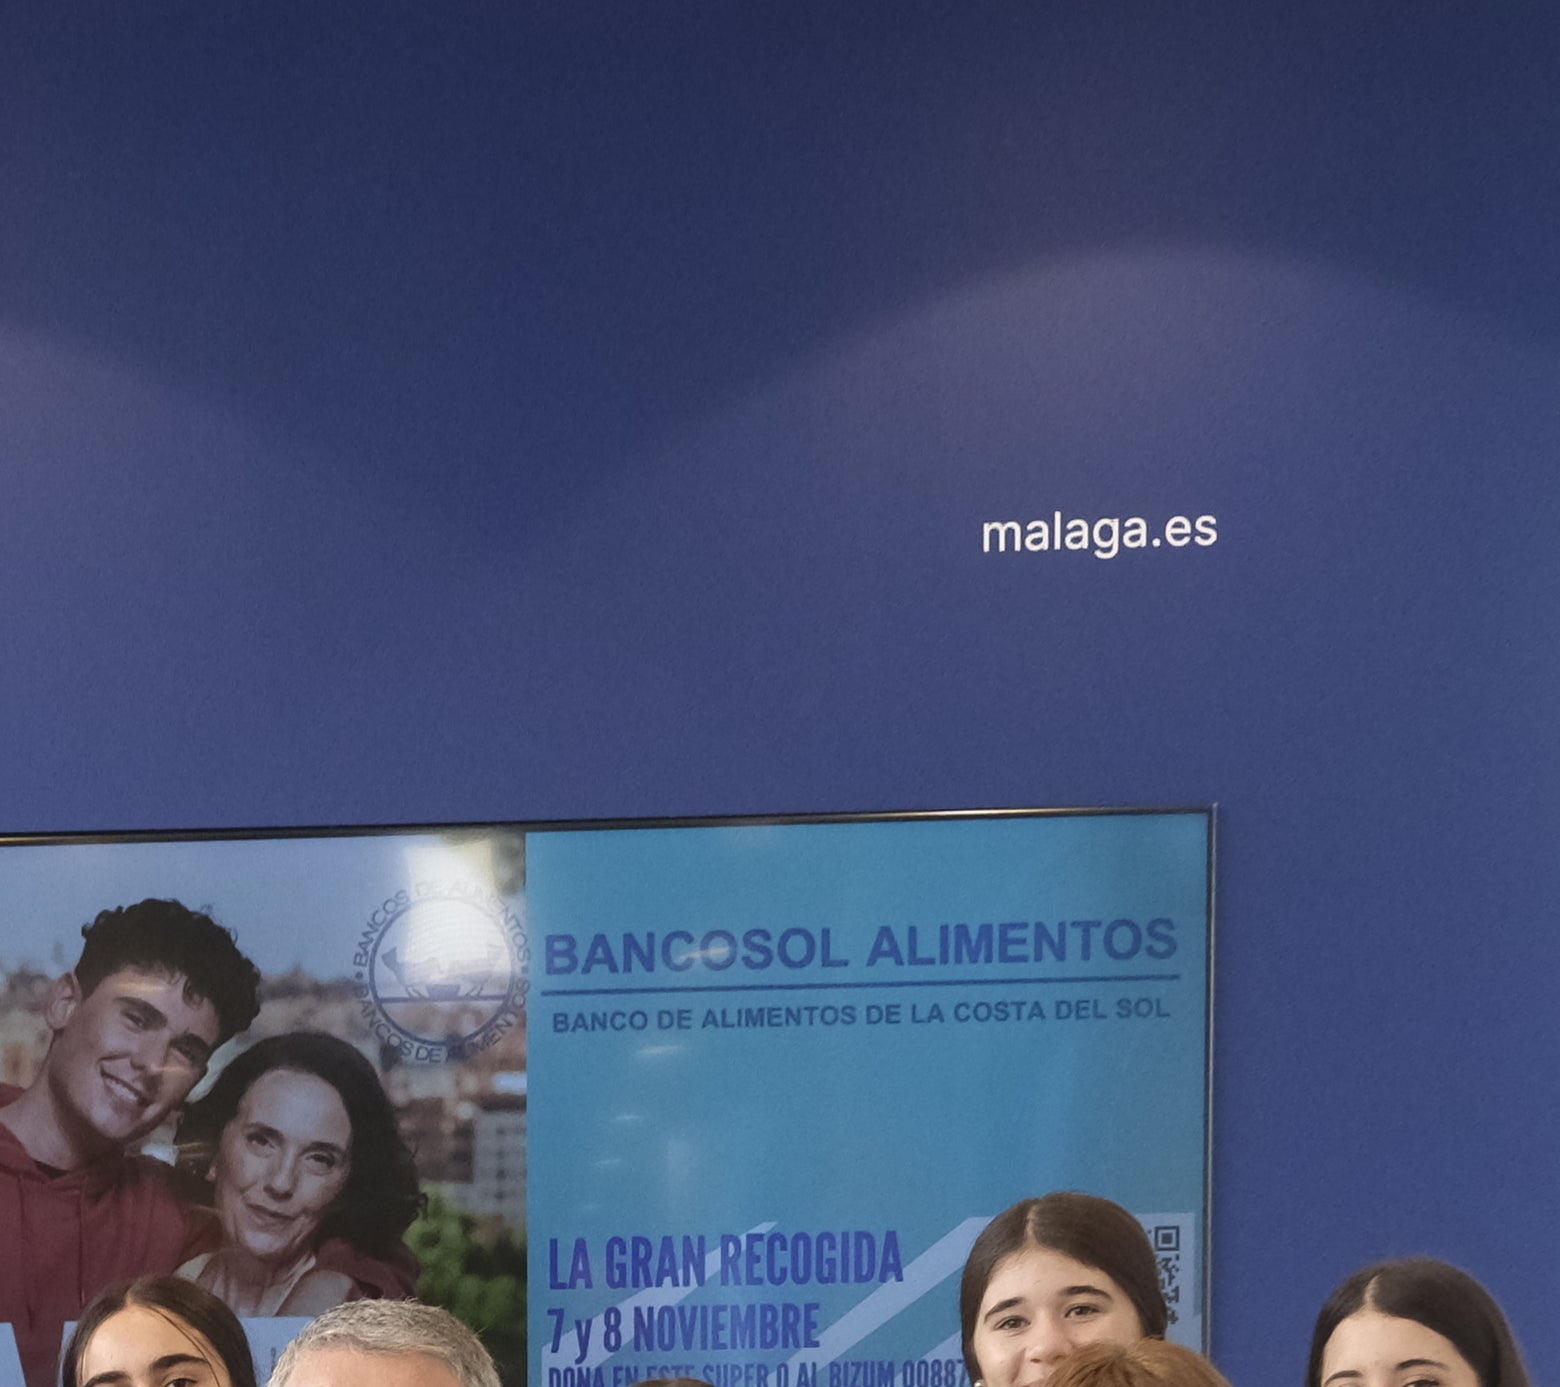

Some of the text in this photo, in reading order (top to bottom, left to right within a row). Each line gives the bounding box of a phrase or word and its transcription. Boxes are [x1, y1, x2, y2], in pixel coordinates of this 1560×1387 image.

[982, 511, 1218, 560] malaga.es
[545, 917, 1179, 976] BANCOSOL ALIMENTOS
[552, 996, 1171, 1033] BANCO DE ALIMENTOS DE LA COSTA DEL SOL
[415, 1044, 442, 1064] DE
[549, 1230, 904, 1290] LA GRAN RECOGIDA
[546, 1302, 820, 1364] 7 y 8 NOVIEMBRE
